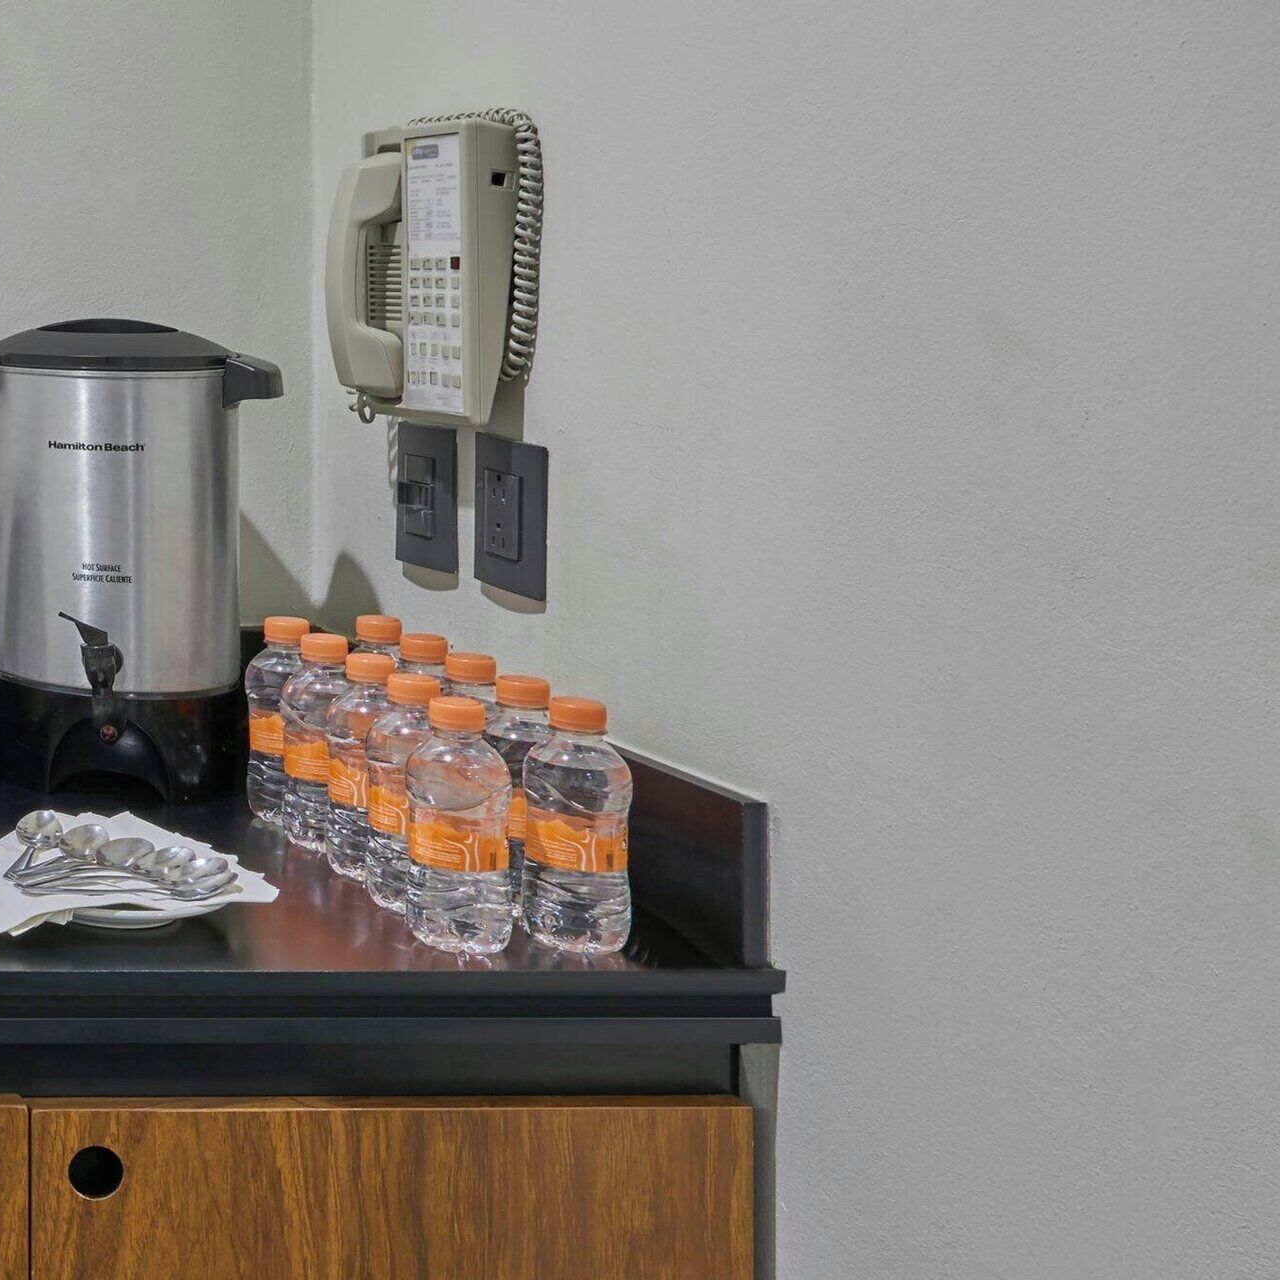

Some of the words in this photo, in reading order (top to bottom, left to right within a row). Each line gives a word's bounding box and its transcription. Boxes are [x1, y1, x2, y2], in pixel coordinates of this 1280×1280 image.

[48, 440, 103, 452] Hamilton
[104, 442, 144, 452] Beach
[81, 563, 95, 571] HOT
[95, 563, 121, 573] SURFACE
[71, 572, 104, 583] SUPERFICIE
[105, 574, 132, 584] CALIENTE
